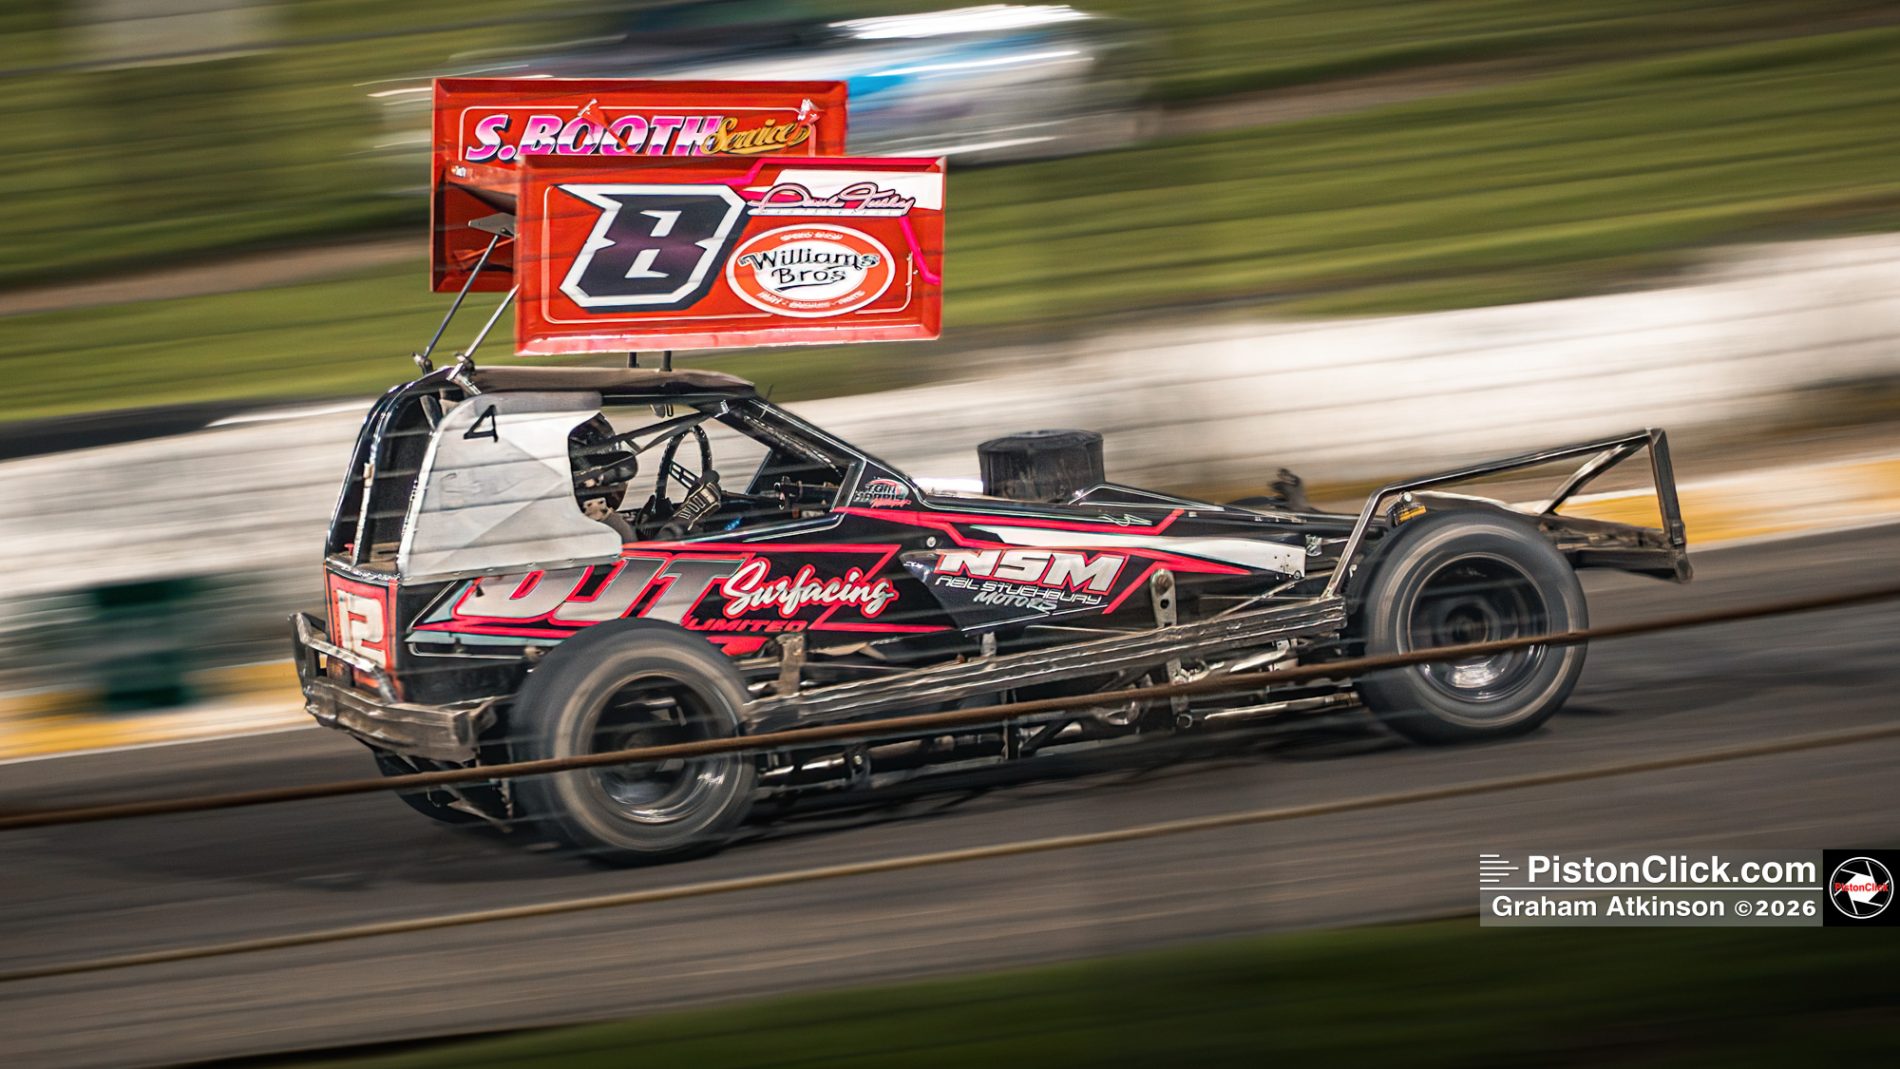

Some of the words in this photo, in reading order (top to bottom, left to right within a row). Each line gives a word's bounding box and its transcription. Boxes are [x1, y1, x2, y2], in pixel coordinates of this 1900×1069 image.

[465, 115, 723, 160] S.BOOTH
[554, 184, 747, 312] 8
[739, 248, 880, 271] Williams
[463, 404, 498, 443] 4
[452, 557, 747, 626] DJT
[722, 560, 895, 616] Surfacing
[934, 575, 980, 591] NEIL
[935, 549, 1129, 595] NSM
[972, 591, 1058, 613] MOTORS
[336, 589, 387, 670] 12
[685, 618, 808, 632] LIMITED
